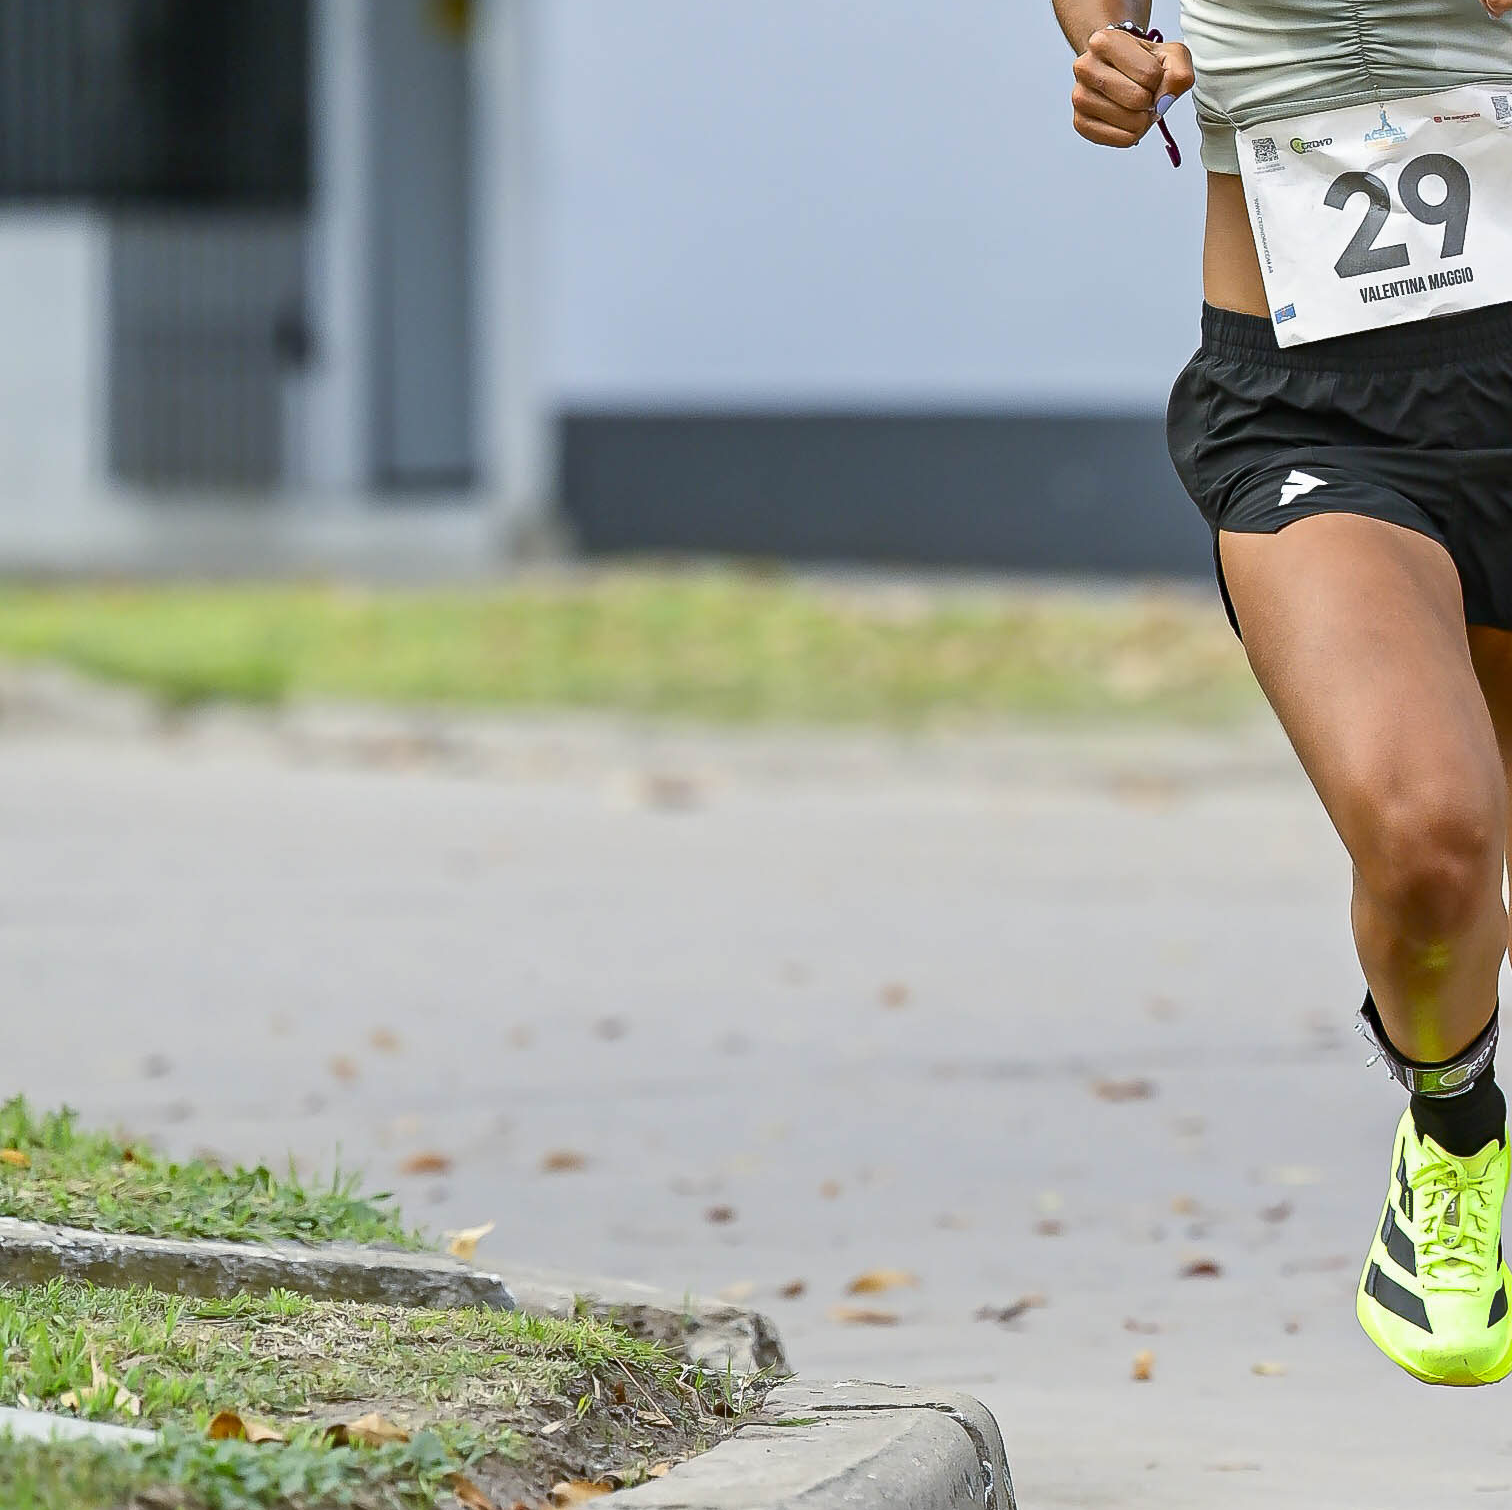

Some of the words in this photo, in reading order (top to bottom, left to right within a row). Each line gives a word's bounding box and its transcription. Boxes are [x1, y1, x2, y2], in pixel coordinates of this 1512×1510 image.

[1323, 153, 1471, 279] 29
[1359, 276, 1427, 304] VALENTINA
[1427, 266, 1474, 291] MAGGIO
